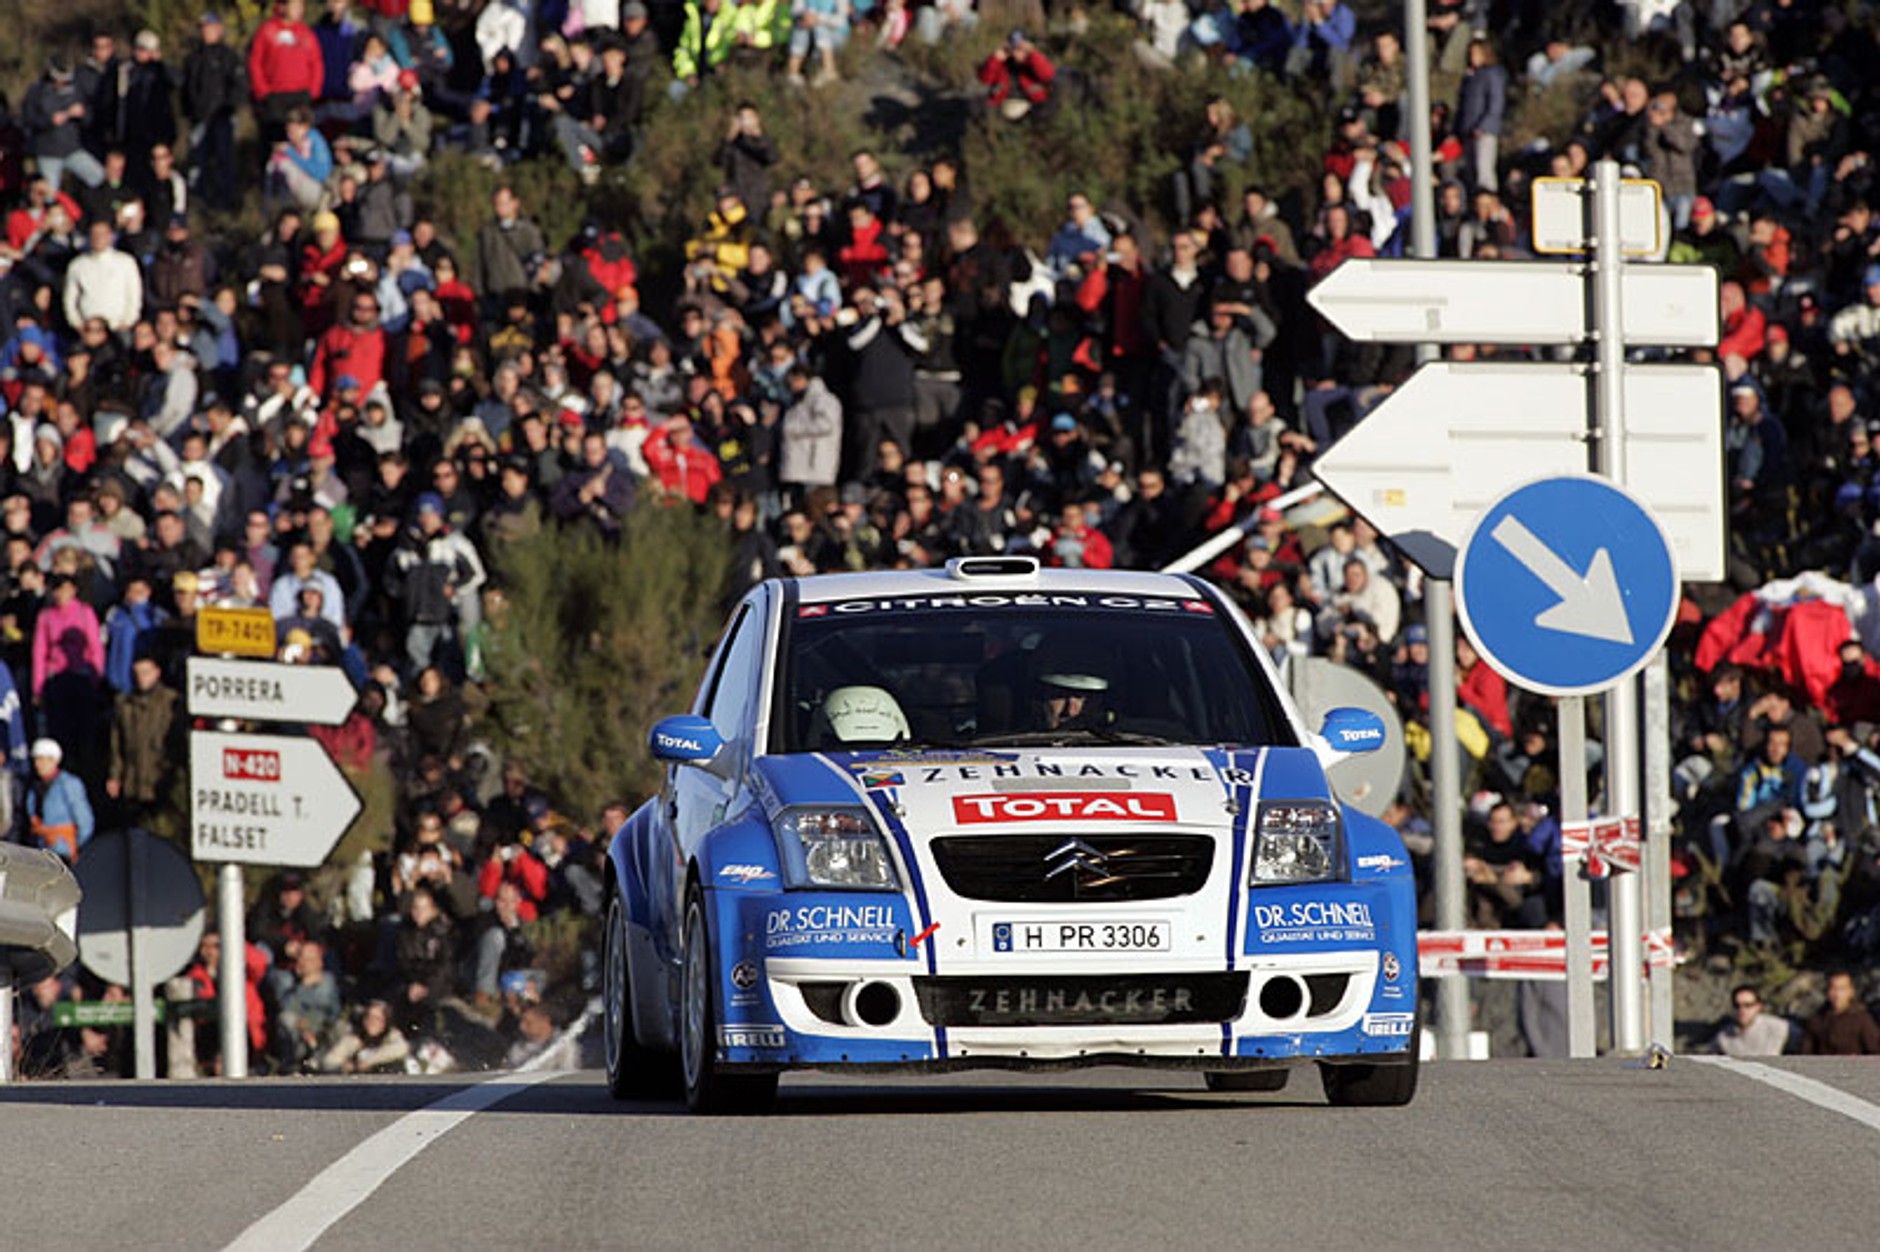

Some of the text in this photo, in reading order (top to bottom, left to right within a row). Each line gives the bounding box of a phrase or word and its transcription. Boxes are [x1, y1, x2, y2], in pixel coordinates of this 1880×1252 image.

[833, 593, 1180, 613] CITROËN C2
[193, 674, 284, 702] PORRERA
[656, 733, 702, 751] TOTAL
[1339, 728, 1381, 742] TOTAL
[225, 753, 278, 777] N-420
[921, 763, 1251, 784] ZEHNACKER
[197, 788, 282, 817] PRADELL
[962, 797, 1166, 818] TOTAL
[197, 823, 267, 849] FALSET
[1025, 925, 1160, 948] H PR 3306
[968, 988, 1193, 1014] ZEHNACKER
